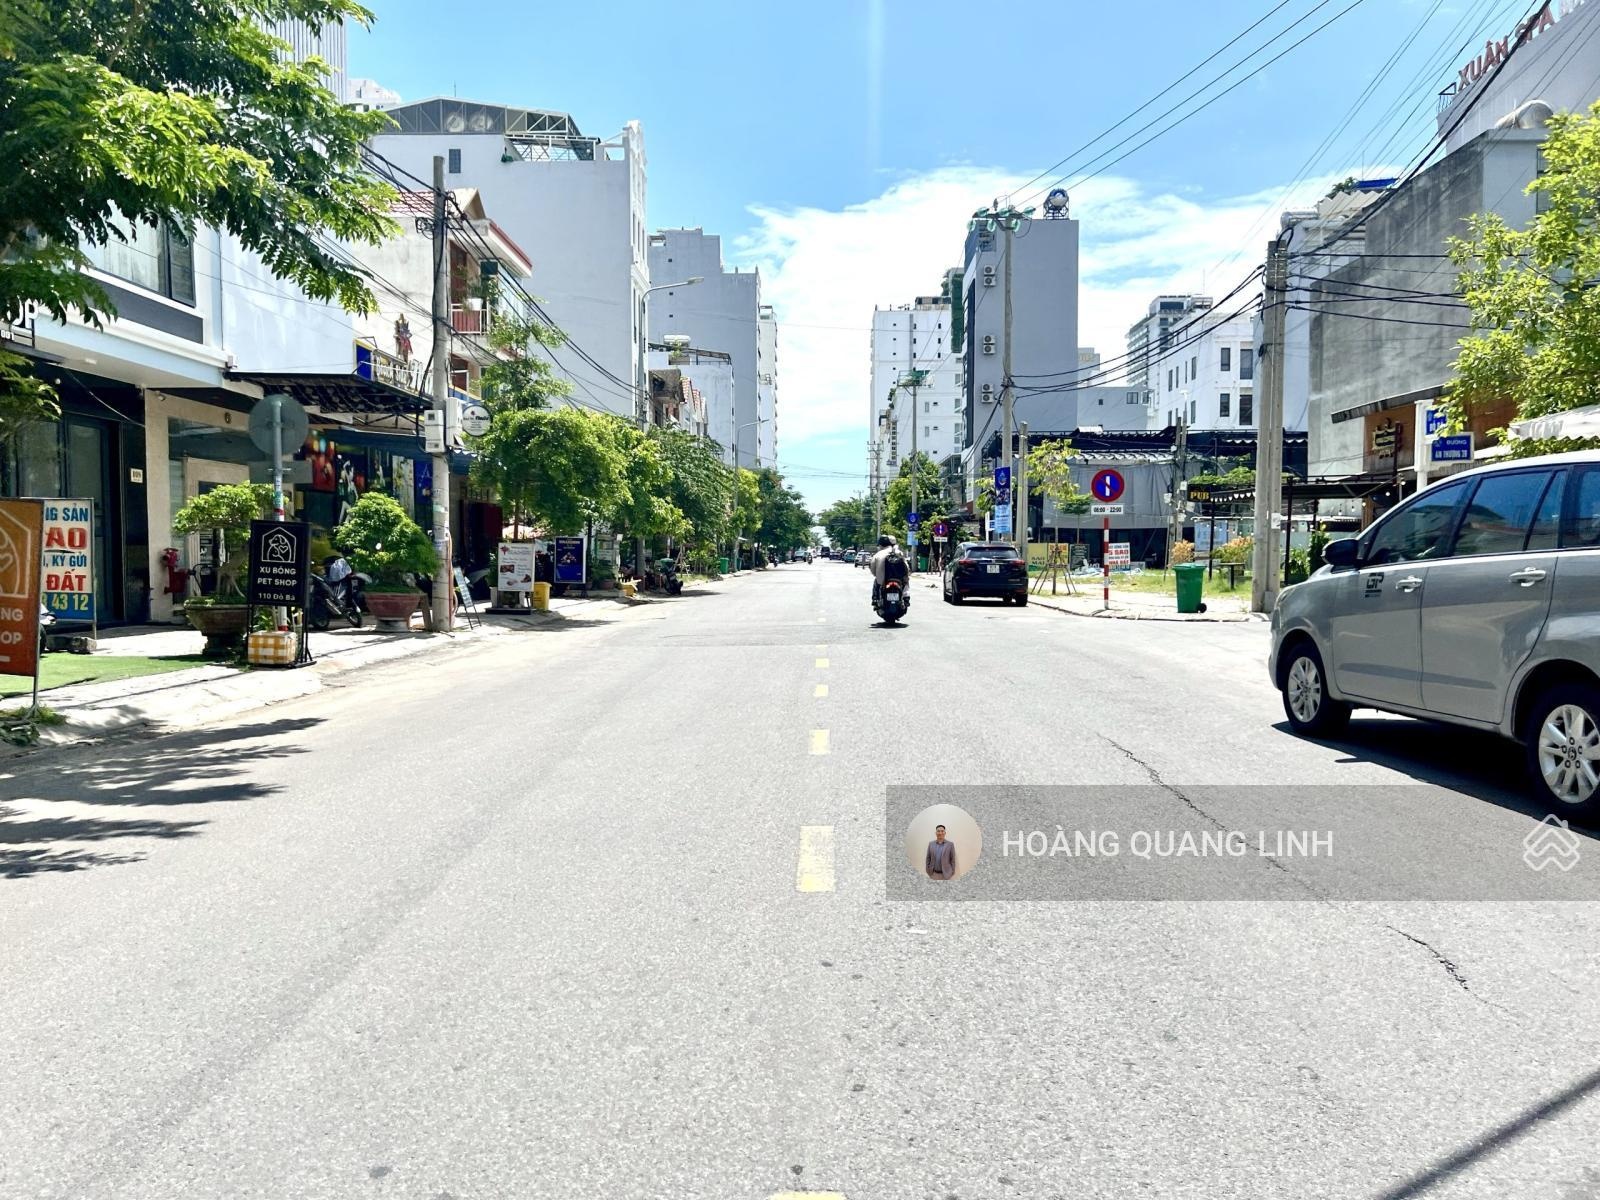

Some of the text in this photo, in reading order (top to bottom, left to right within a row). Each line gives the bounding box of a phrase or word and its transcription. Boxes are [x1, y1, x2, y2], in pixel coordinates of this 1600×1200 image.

[1458, 35, 1509, 91] XUÂN
[1190, 491, 1210, 500] PUB
[63, 503, 89, 522] SẢN
[52, 553, 65, 566] KÝ
[69, 551, 87, 567] GỬI
[46, 569, 86, 591] ĐẤT
[257, 577, 297, 587] PET SHOP
[52, 594, 68, 611] 43
[73, 594, 88, 611] 12
